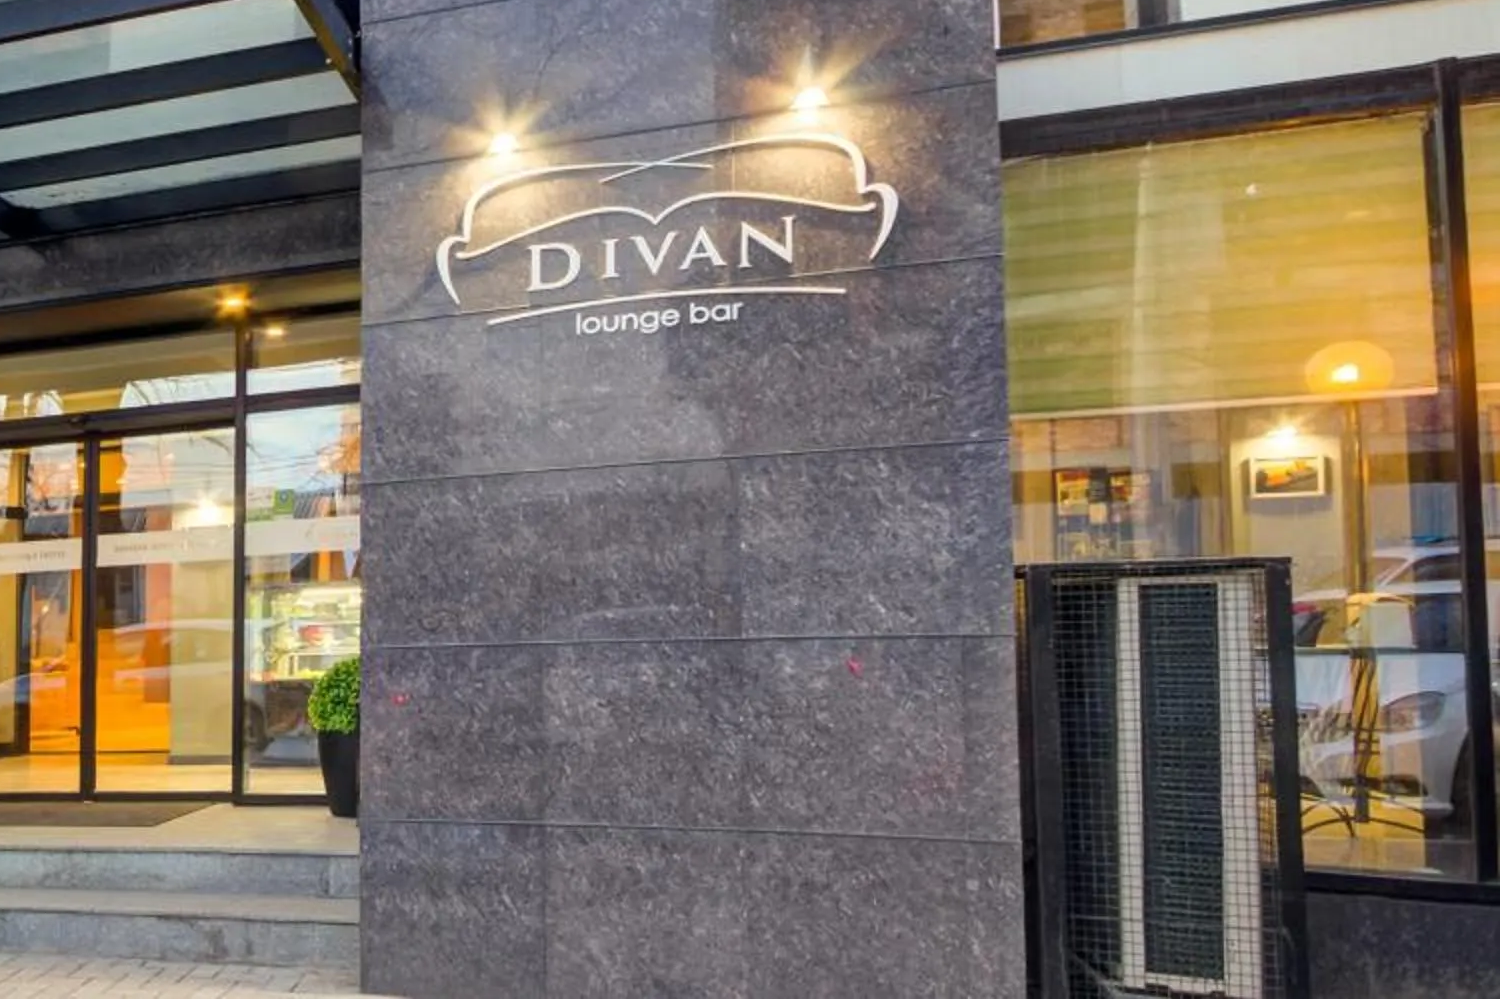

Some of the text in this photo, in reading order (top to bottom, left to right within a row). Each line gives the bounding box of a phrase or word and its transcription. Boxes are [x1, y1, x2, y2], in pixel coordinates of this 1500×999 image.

[526, 214, 797, 292] DIVAN
[575, 301, 745, 335] lounge bar
